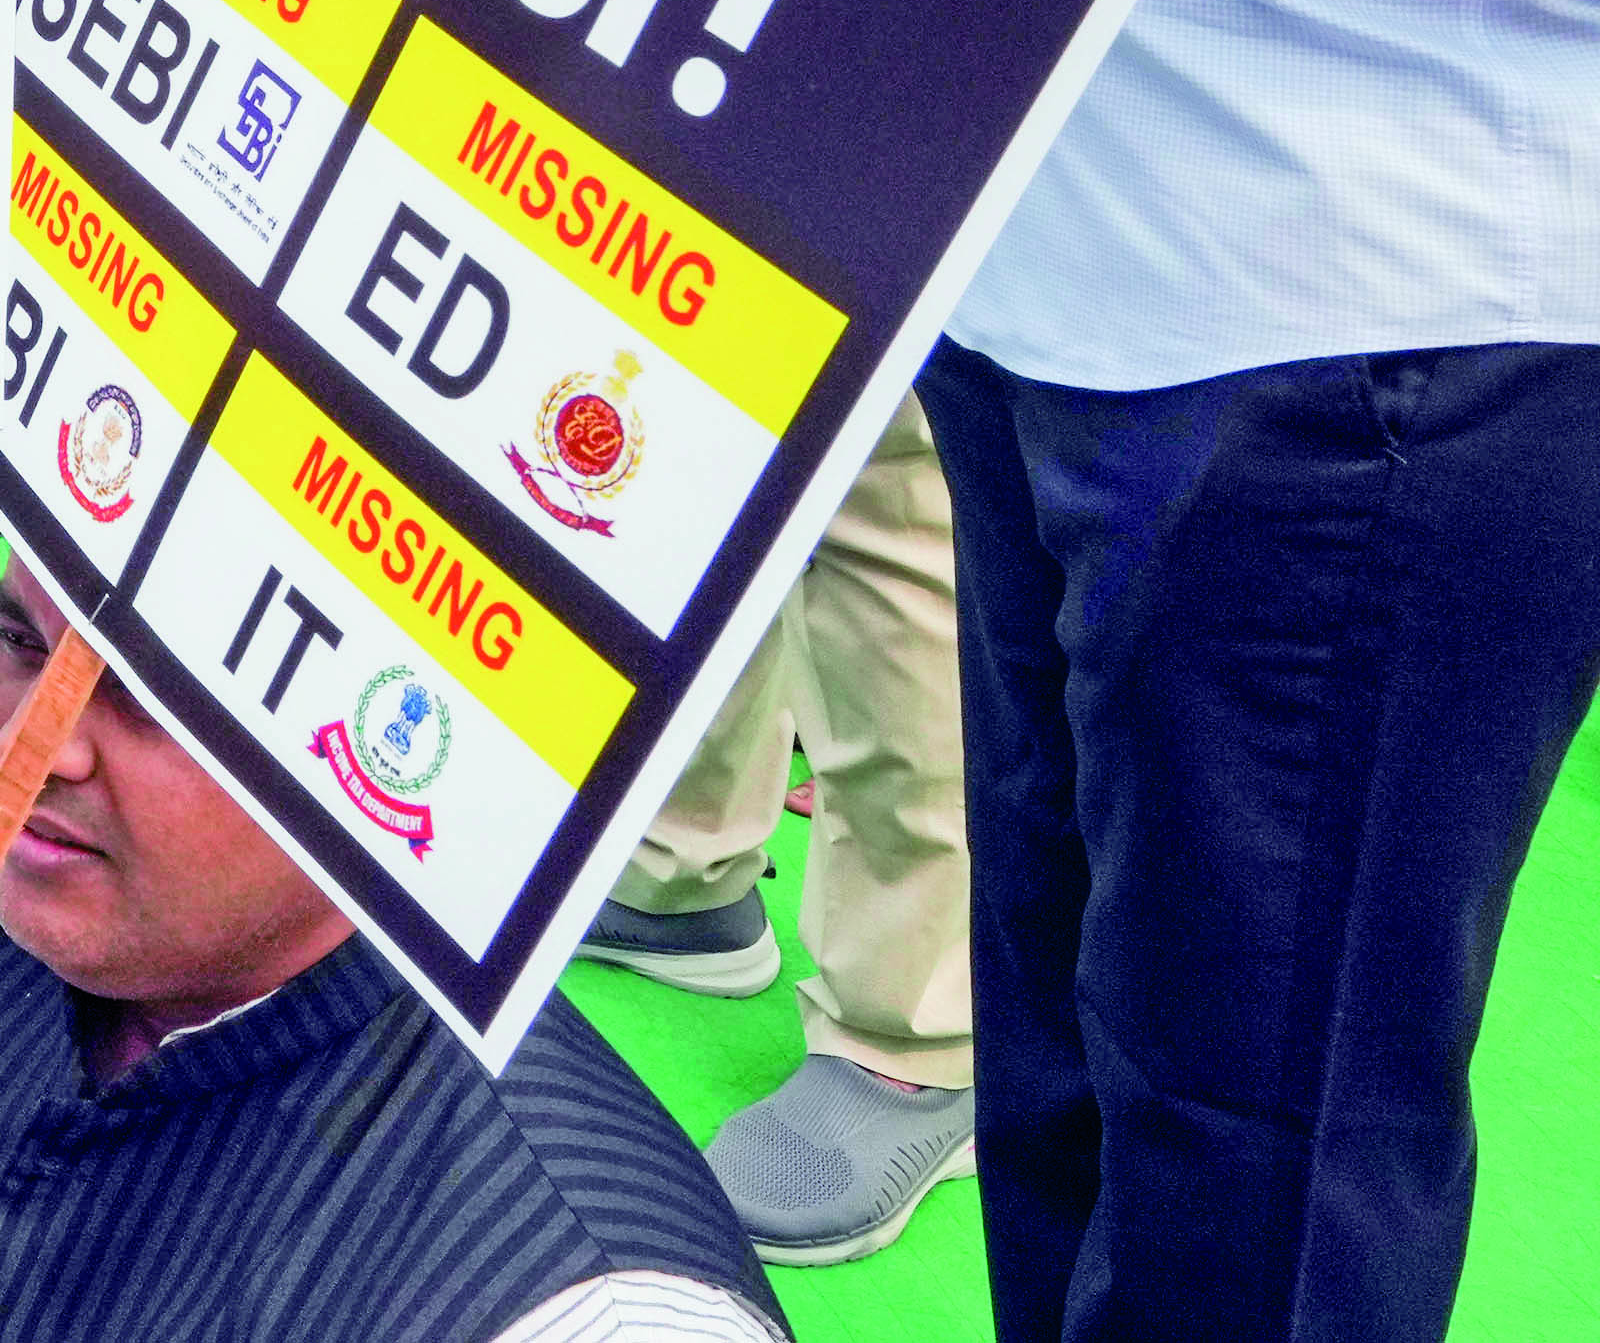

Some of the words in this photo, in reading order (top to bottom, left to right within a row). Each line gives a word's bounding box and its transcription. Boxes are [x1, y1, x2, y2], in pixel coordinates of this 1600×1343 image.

[10, 151, 165, 334] MISSING
[344, 200, 512, 400] ED
[456, 99, 717, 330] MISSING
[2, 277, 68, 429] BI
[221, 565, 345, 715] IT
[291, 434, 524, 674] MISSING
